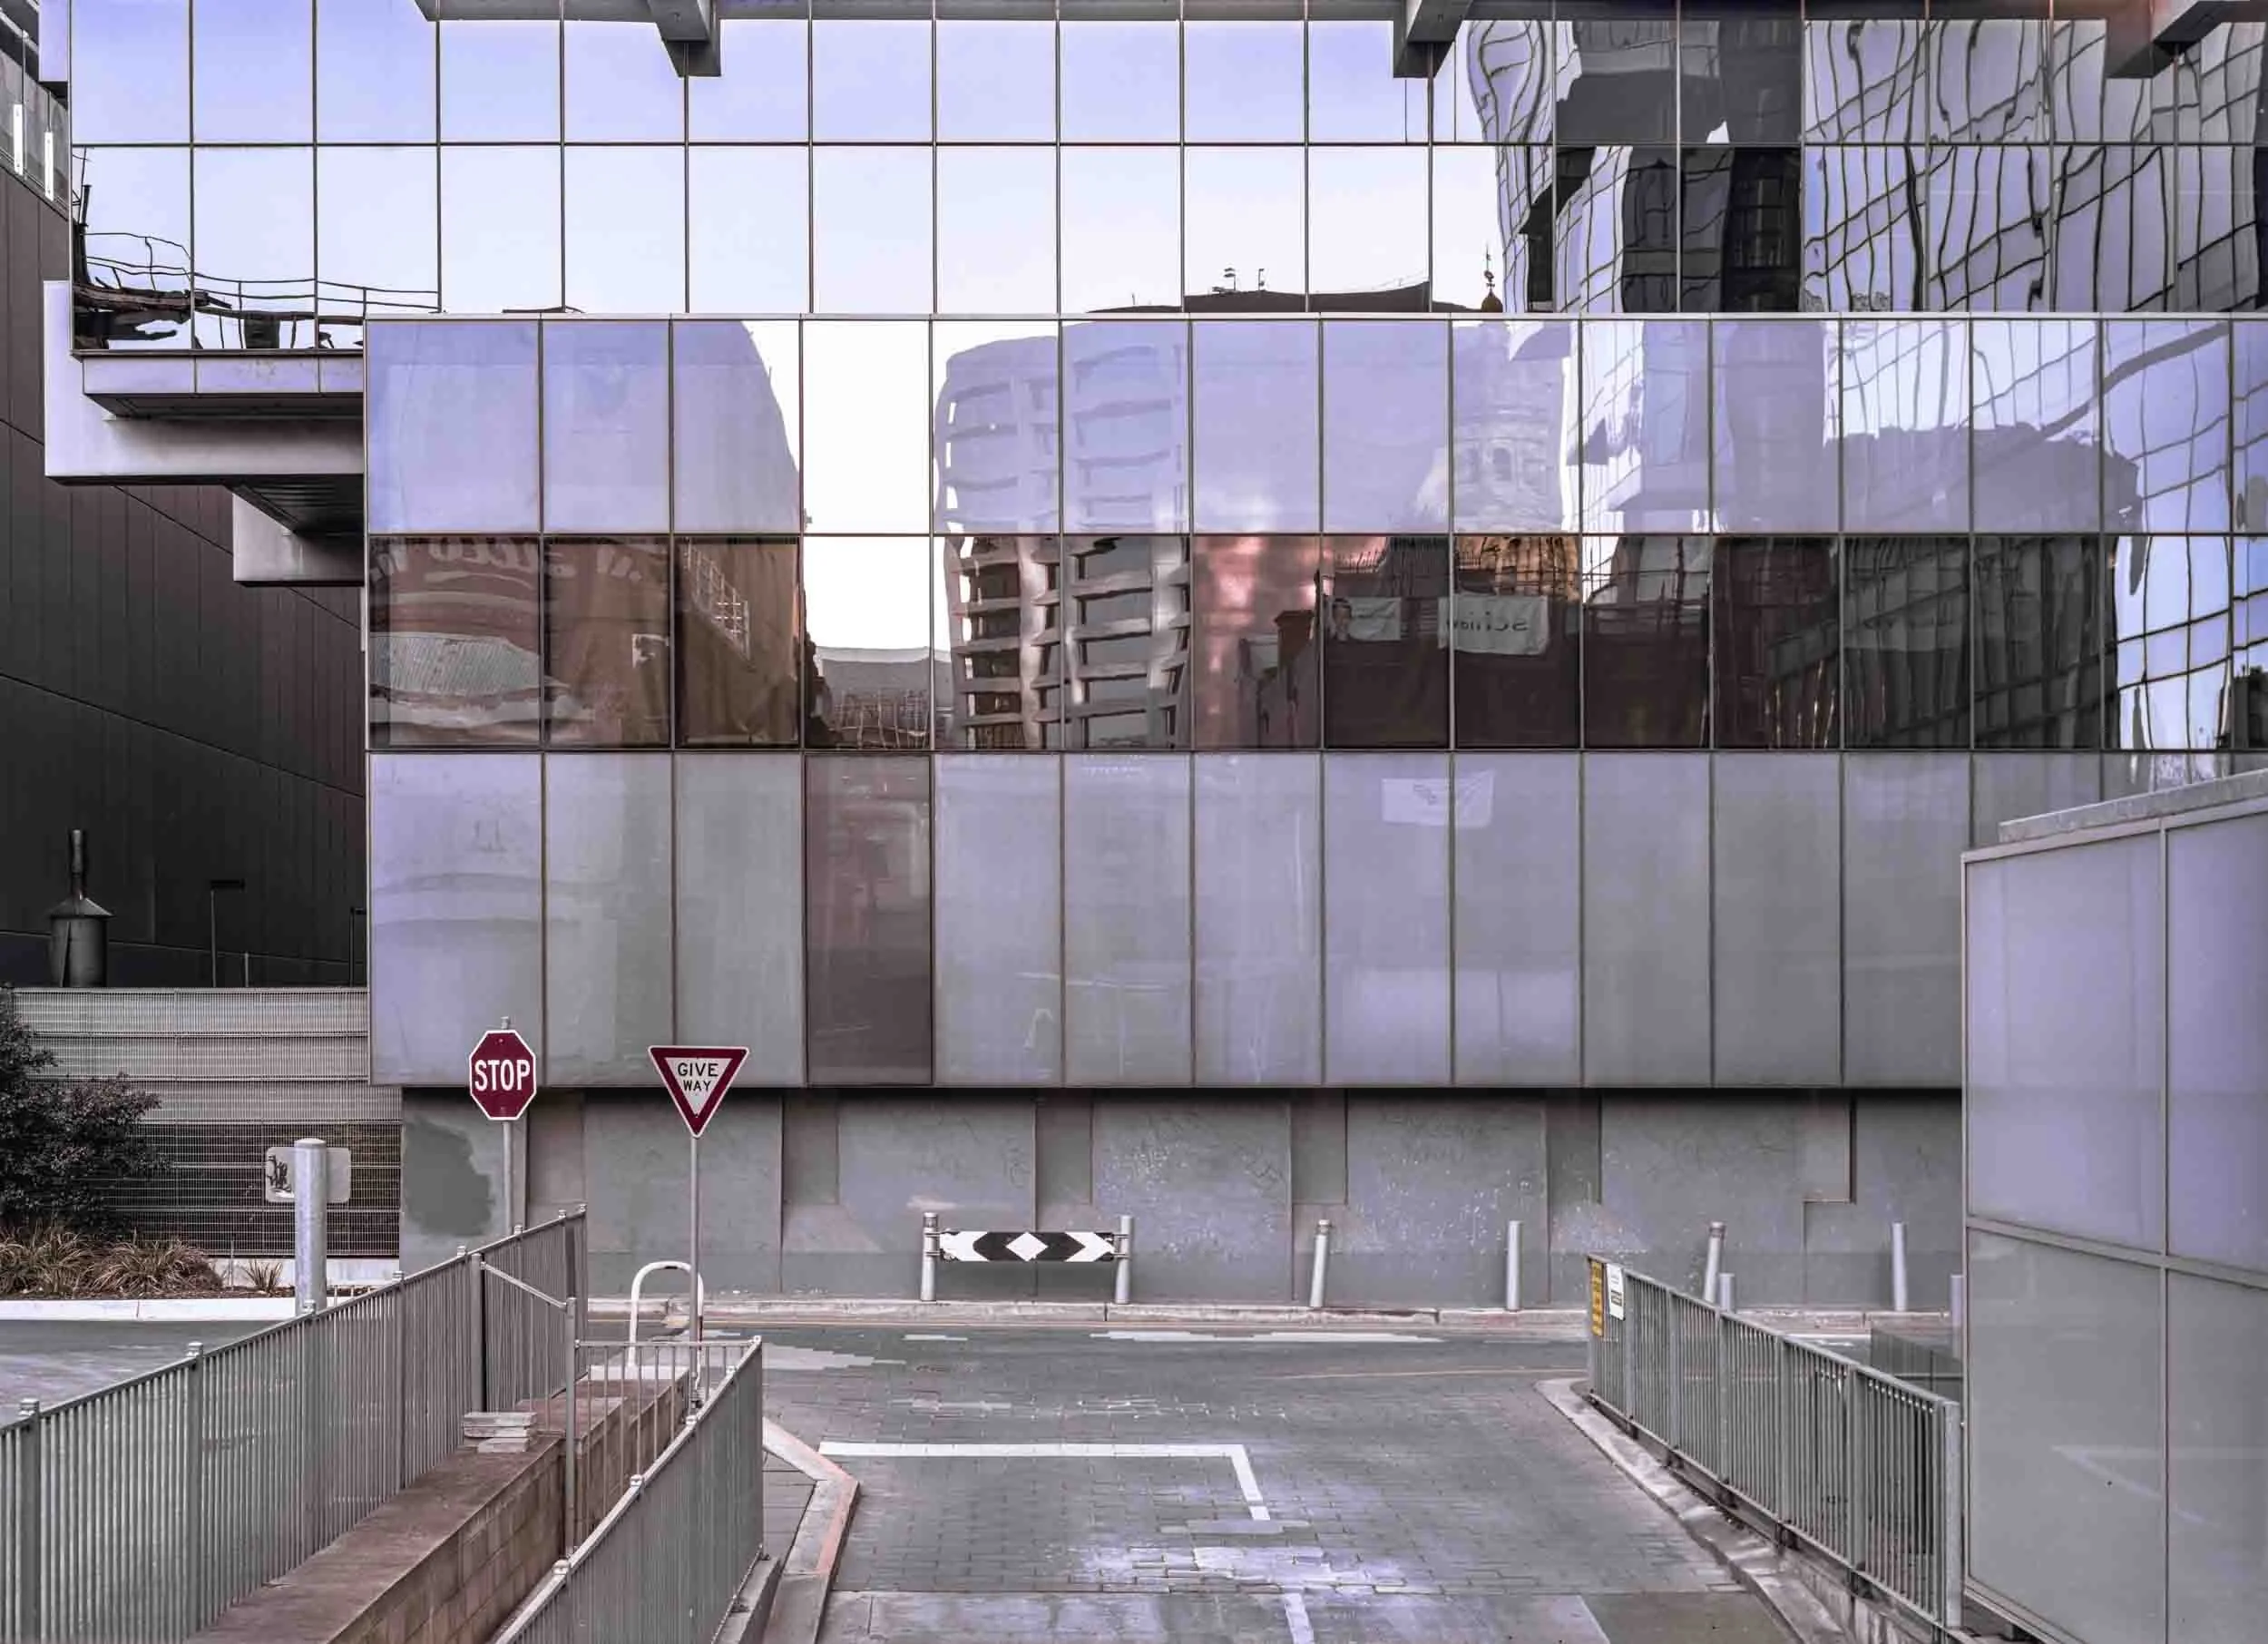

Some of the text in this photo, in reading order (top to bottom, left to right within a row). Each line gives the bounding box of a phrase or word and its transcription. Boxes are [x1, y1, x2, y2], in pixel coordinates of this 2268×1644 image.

[474, 1059, 531, 1091] STOP
[678, 1062, 719, 1077] GIVE
[683, 1080, 711, 1091] WAY
